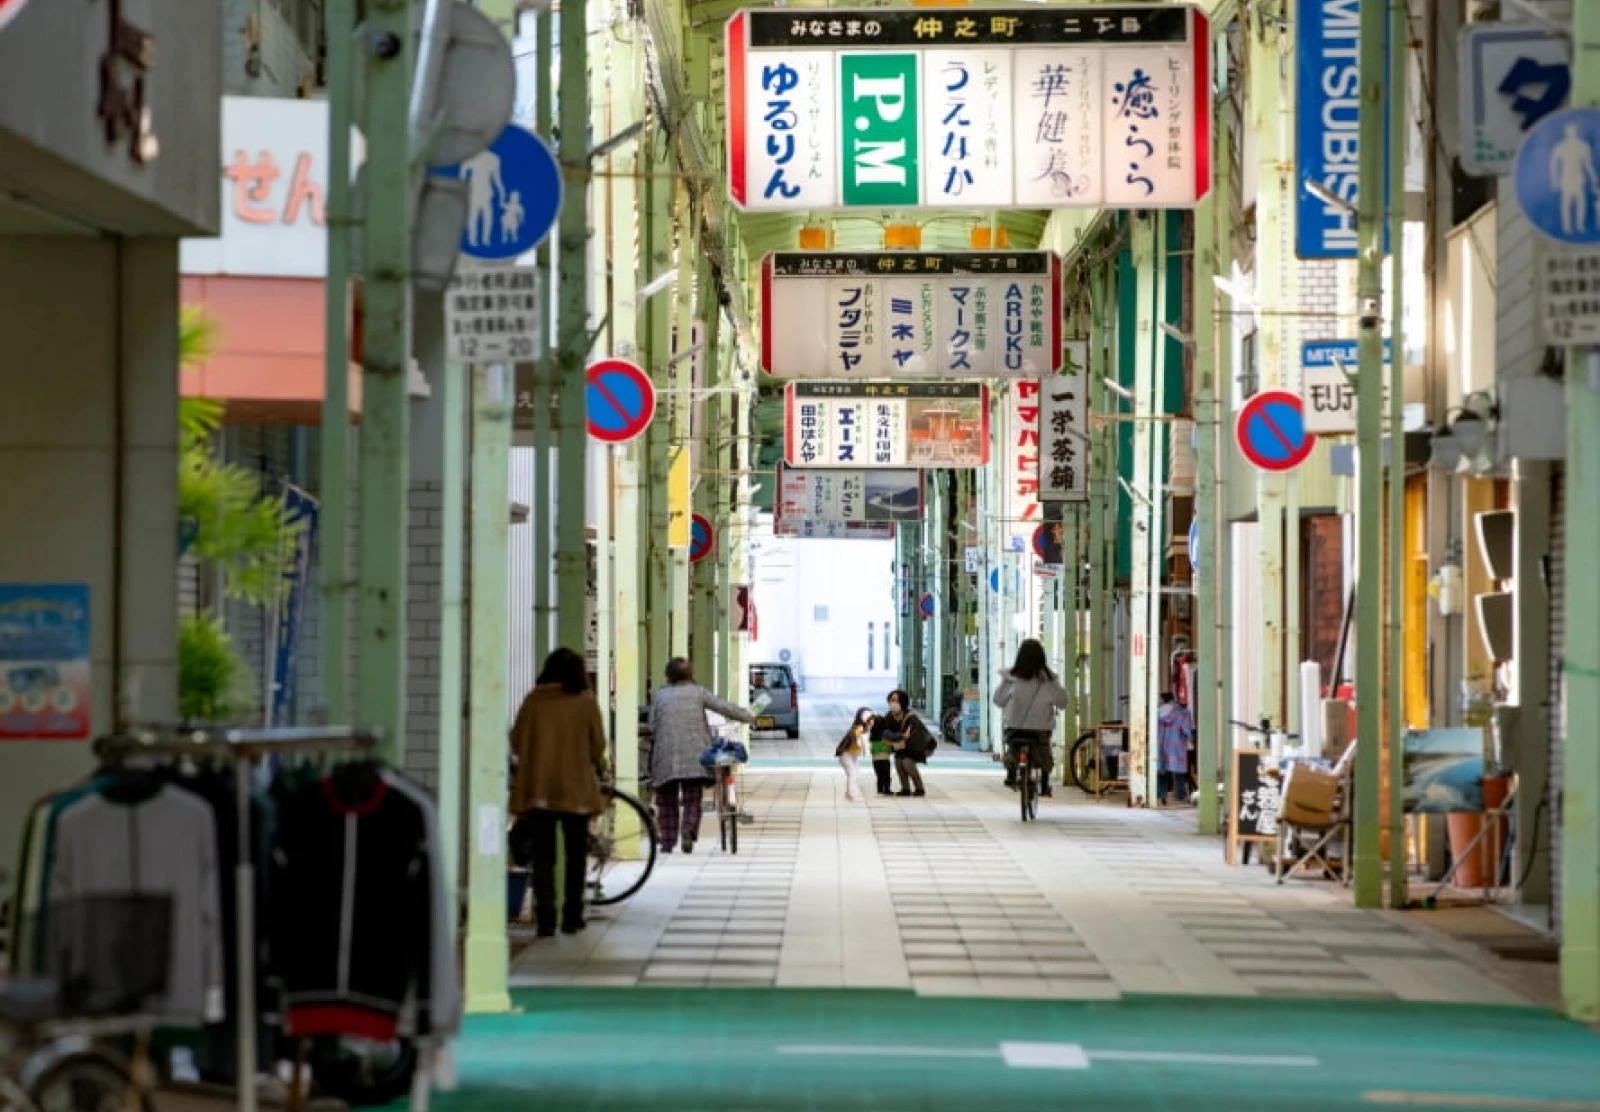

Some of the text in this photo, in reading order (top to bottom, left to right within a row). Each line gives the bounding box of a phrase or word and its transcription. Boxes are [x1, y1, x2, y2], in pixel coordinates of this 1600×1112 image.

[790, 20, 881, 36] みなさまの
[913, 17, 1018, 38] 仲之町
[761, 62, 801, 199] ゆるりん
[853, 72, 907, 188] P.M
[942, 61, 975, 197] うえなか
[1112, 68, 1159, 197] 癒らら
[877, 256, 944, 272] 仲之町
[949, 287, 971, 369] マークス
[1005, 283, 1024, 369] ARUKU
[838, 407, 855, 462] エース
